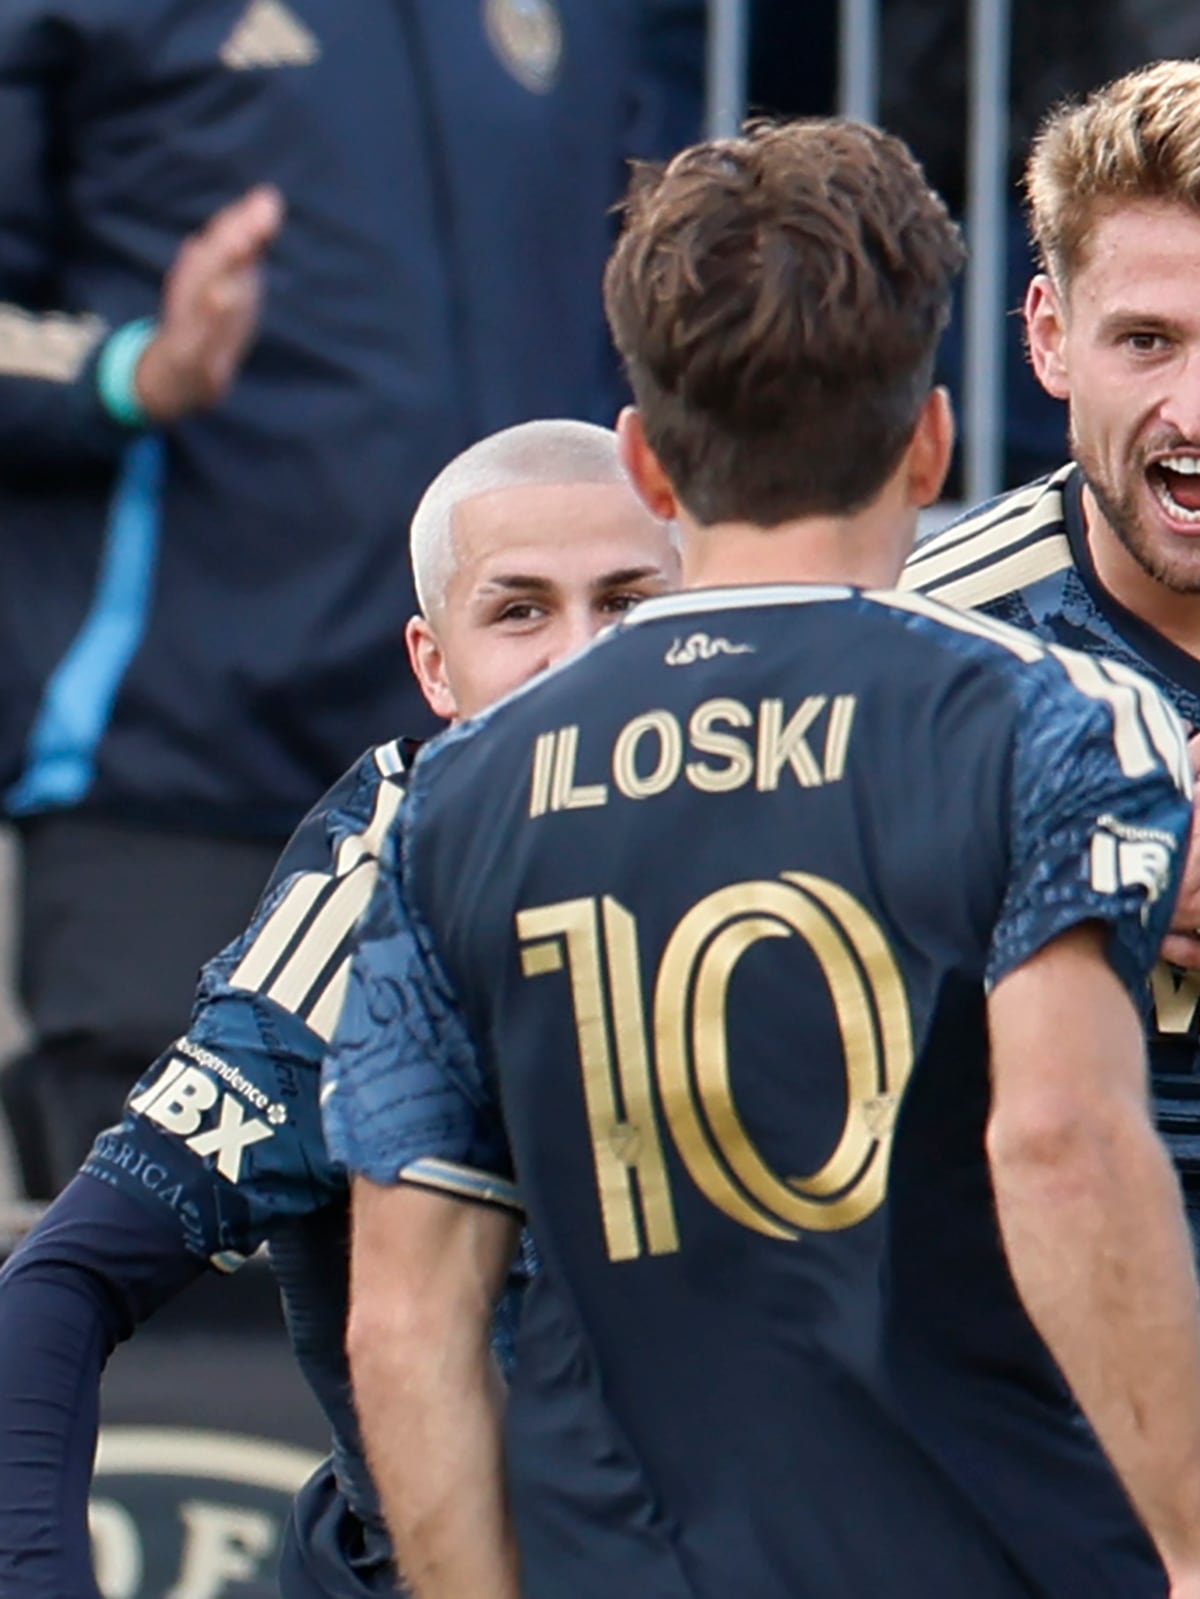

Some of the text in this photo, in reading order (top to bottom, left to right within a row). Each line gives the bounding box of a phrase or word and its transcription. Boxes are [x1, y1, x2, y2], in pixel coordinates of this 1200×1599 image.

[529, 694, 858, 820] ILOSKI
[129, 1057, 276, 1185] IBX
[515, 871, 914, 1262] 10
